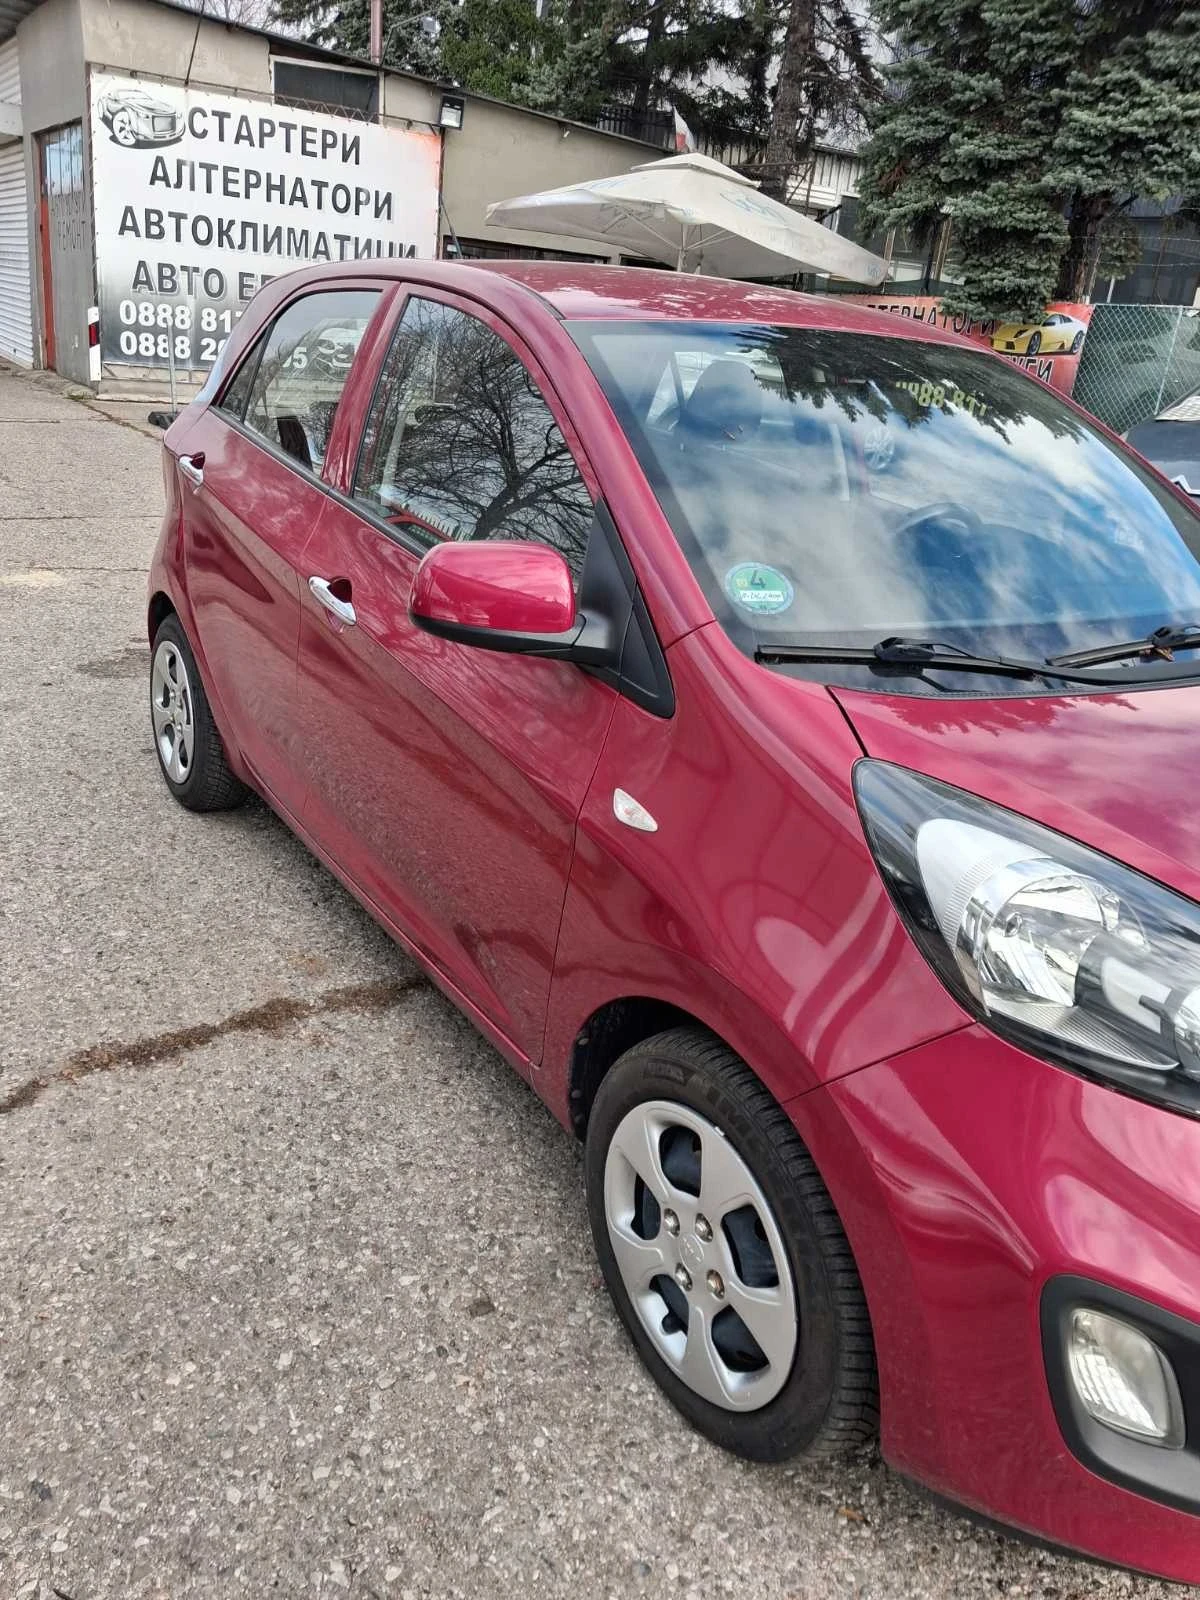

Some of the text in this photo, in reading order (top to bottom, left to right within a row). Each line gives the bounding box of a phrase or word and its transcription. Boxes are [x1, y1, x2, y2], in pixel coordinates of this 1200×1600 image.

[188, 106, 361, 166] СТАРТЕРИ
[148, 155, 394, 221] АЛТЕРНАТОРИ
[132, 260, 277, 301] АВТО Е
[119, 300, 244, 333] 0888 81
[119, 330, 192, 359] 0888
